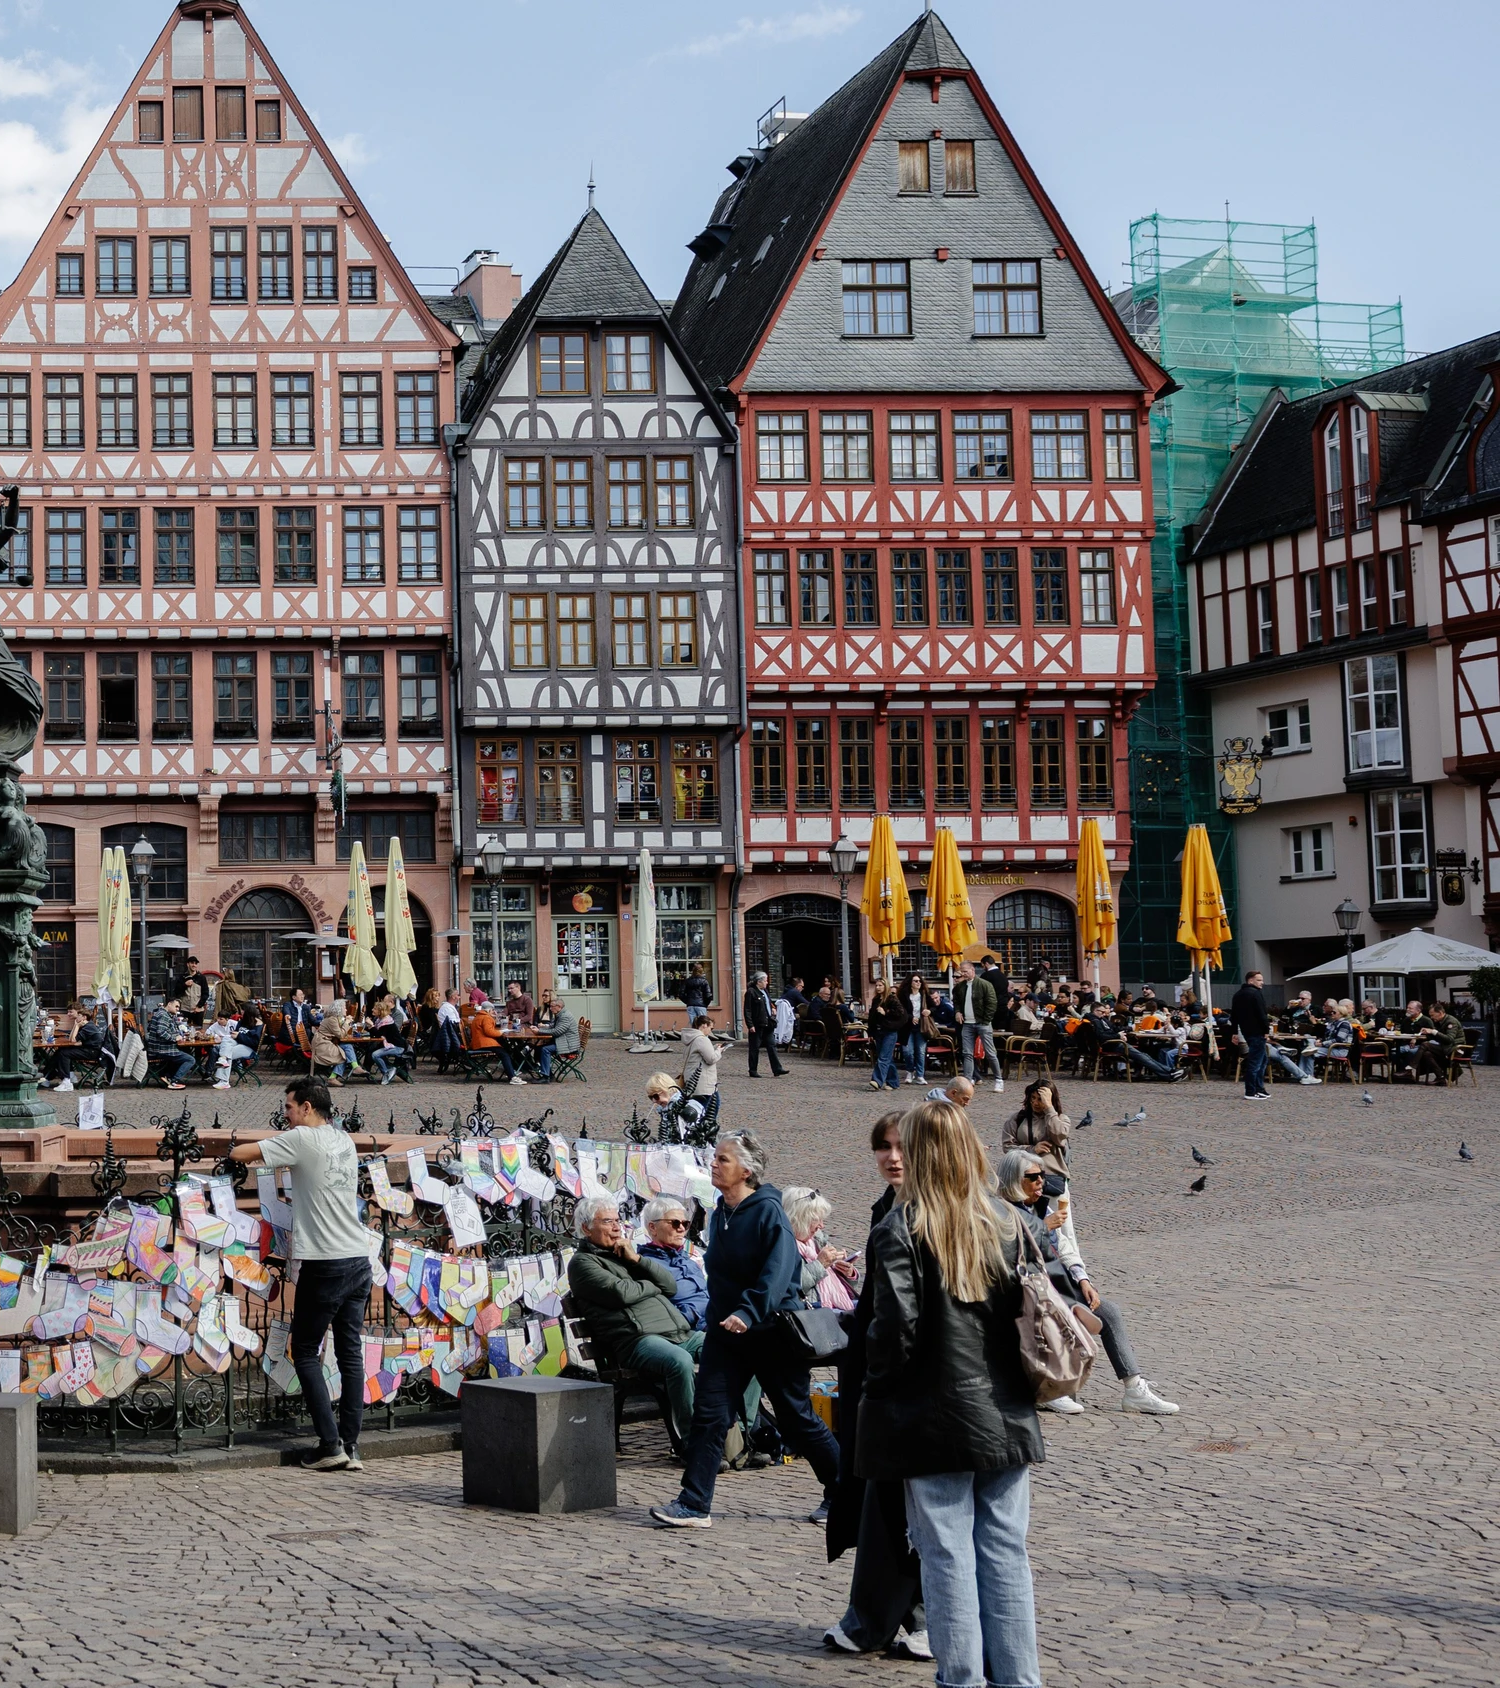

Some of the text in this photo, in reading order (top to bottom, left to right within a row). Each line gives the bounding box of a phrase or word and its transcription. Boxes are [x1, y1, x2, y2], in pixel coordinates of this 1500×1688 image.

[203, 874, 332, 924] Römer Bembel
[42, 932, 68, 941] ATM
[1428, 952, 1490, 962] Bitburger
